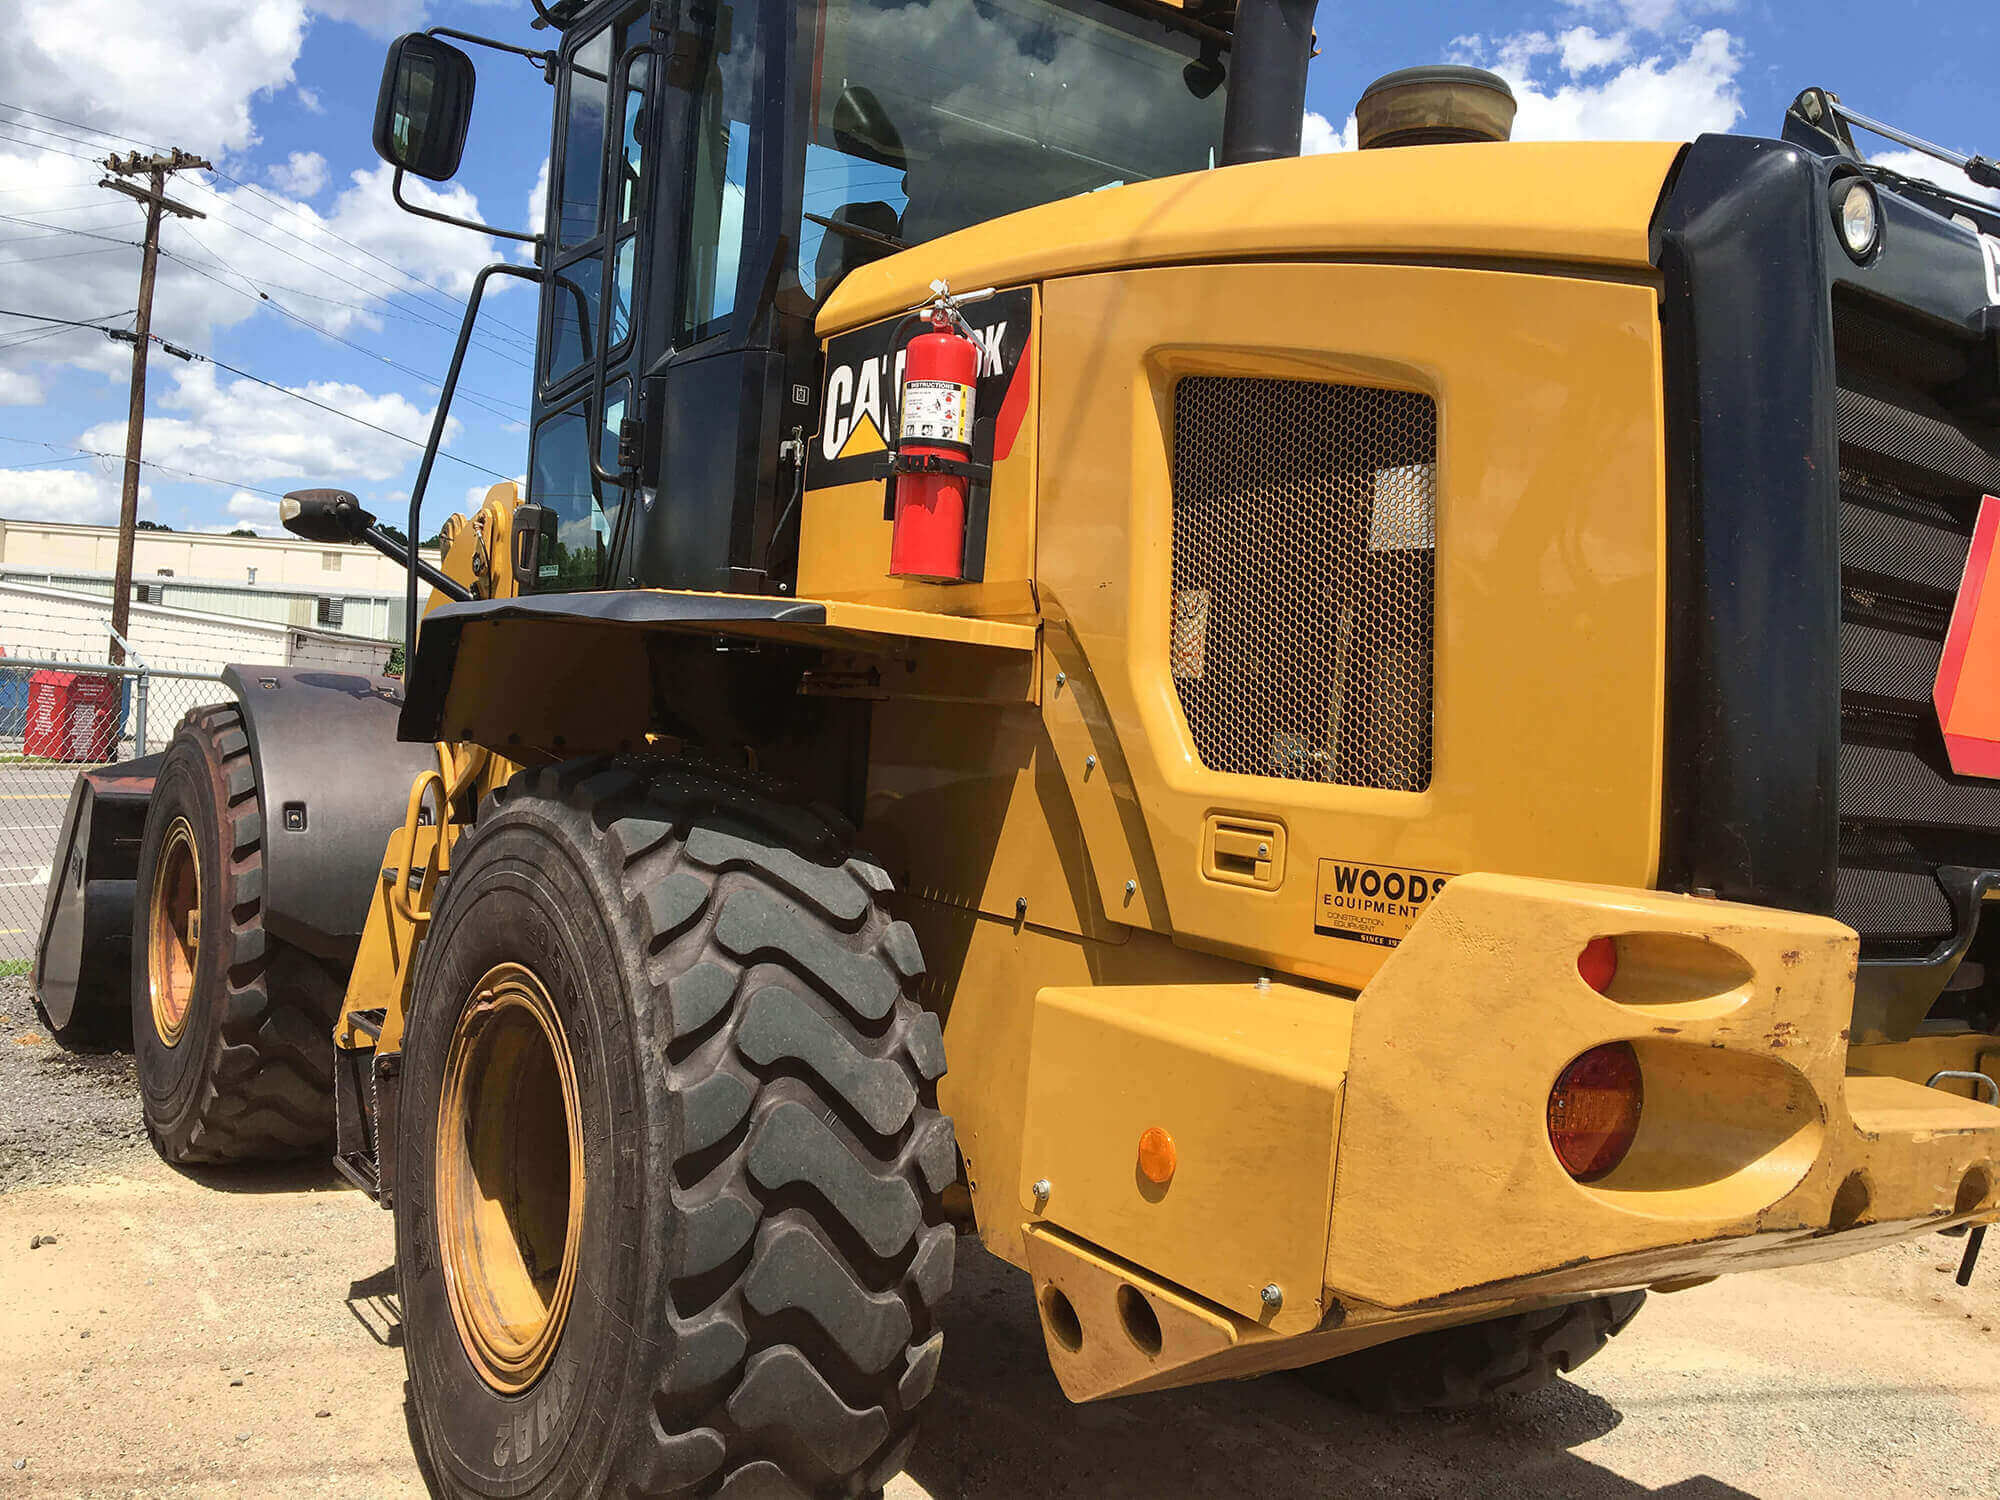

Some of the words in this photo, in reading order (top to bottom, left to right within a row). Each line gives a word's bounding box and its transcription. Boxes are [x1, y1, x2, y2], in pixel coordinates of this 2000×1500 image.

[910, 382, 954, 392] INSTRUCTIONS
[1334, 865, 1447, 903] WOODS
[1323, 894, 1419, 918] EQUIPMENT
[1327, 911, 1384, 926] CONSTRUCTION
[1333, 919, 1376, 932] EQUIPMENT
[1360, 934, 1384, 945] SINCE
